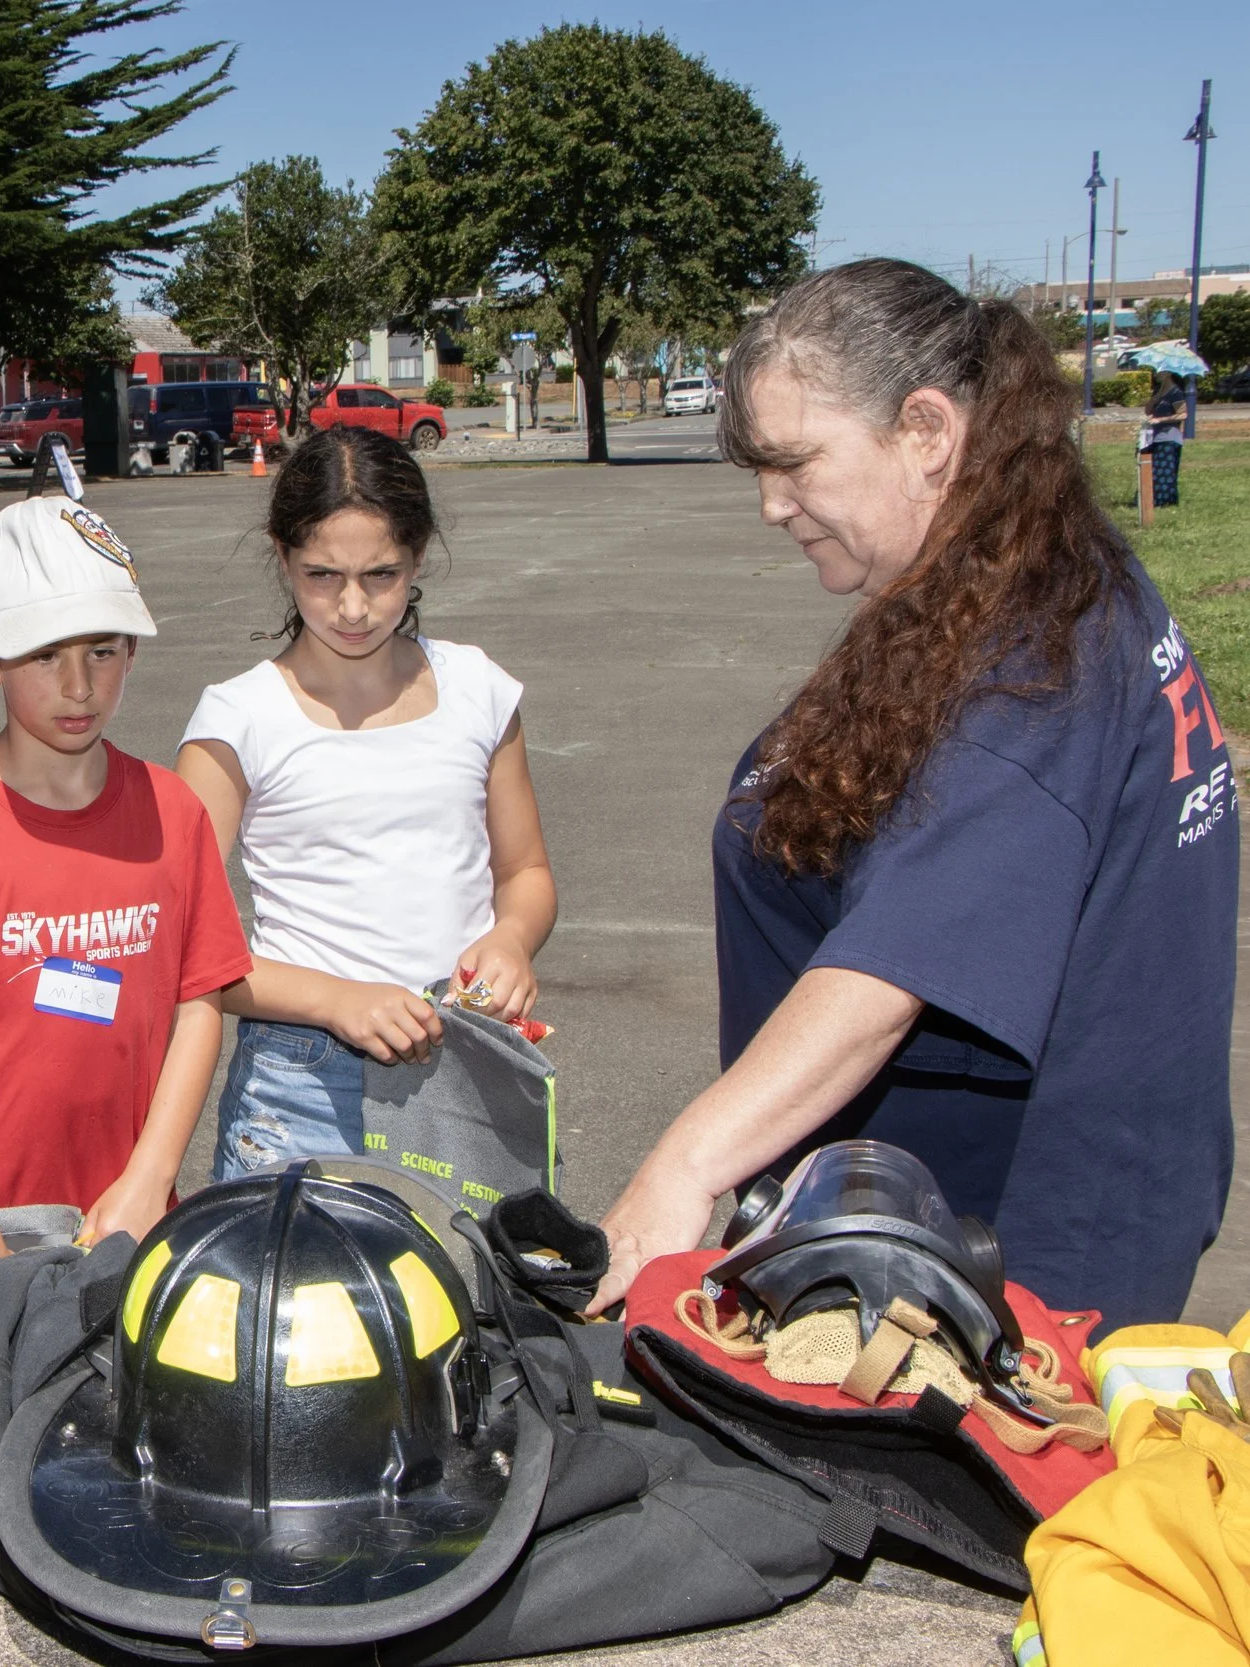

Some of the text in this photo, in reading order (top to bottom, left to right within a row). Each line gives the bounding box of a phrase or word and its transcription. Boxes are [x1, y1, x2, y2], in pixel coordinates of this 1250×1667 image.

[1, 902, 160, 957] SKYHAWKS
[86, 946, 120, 962] SPORTS
[72, 961, 96, 974] Hello
[364, 1132, 388, 1150] ATL
[400, 1151, 454, 1179] SCIENCE
[871, 1219, 920, 1236] SCOTT
